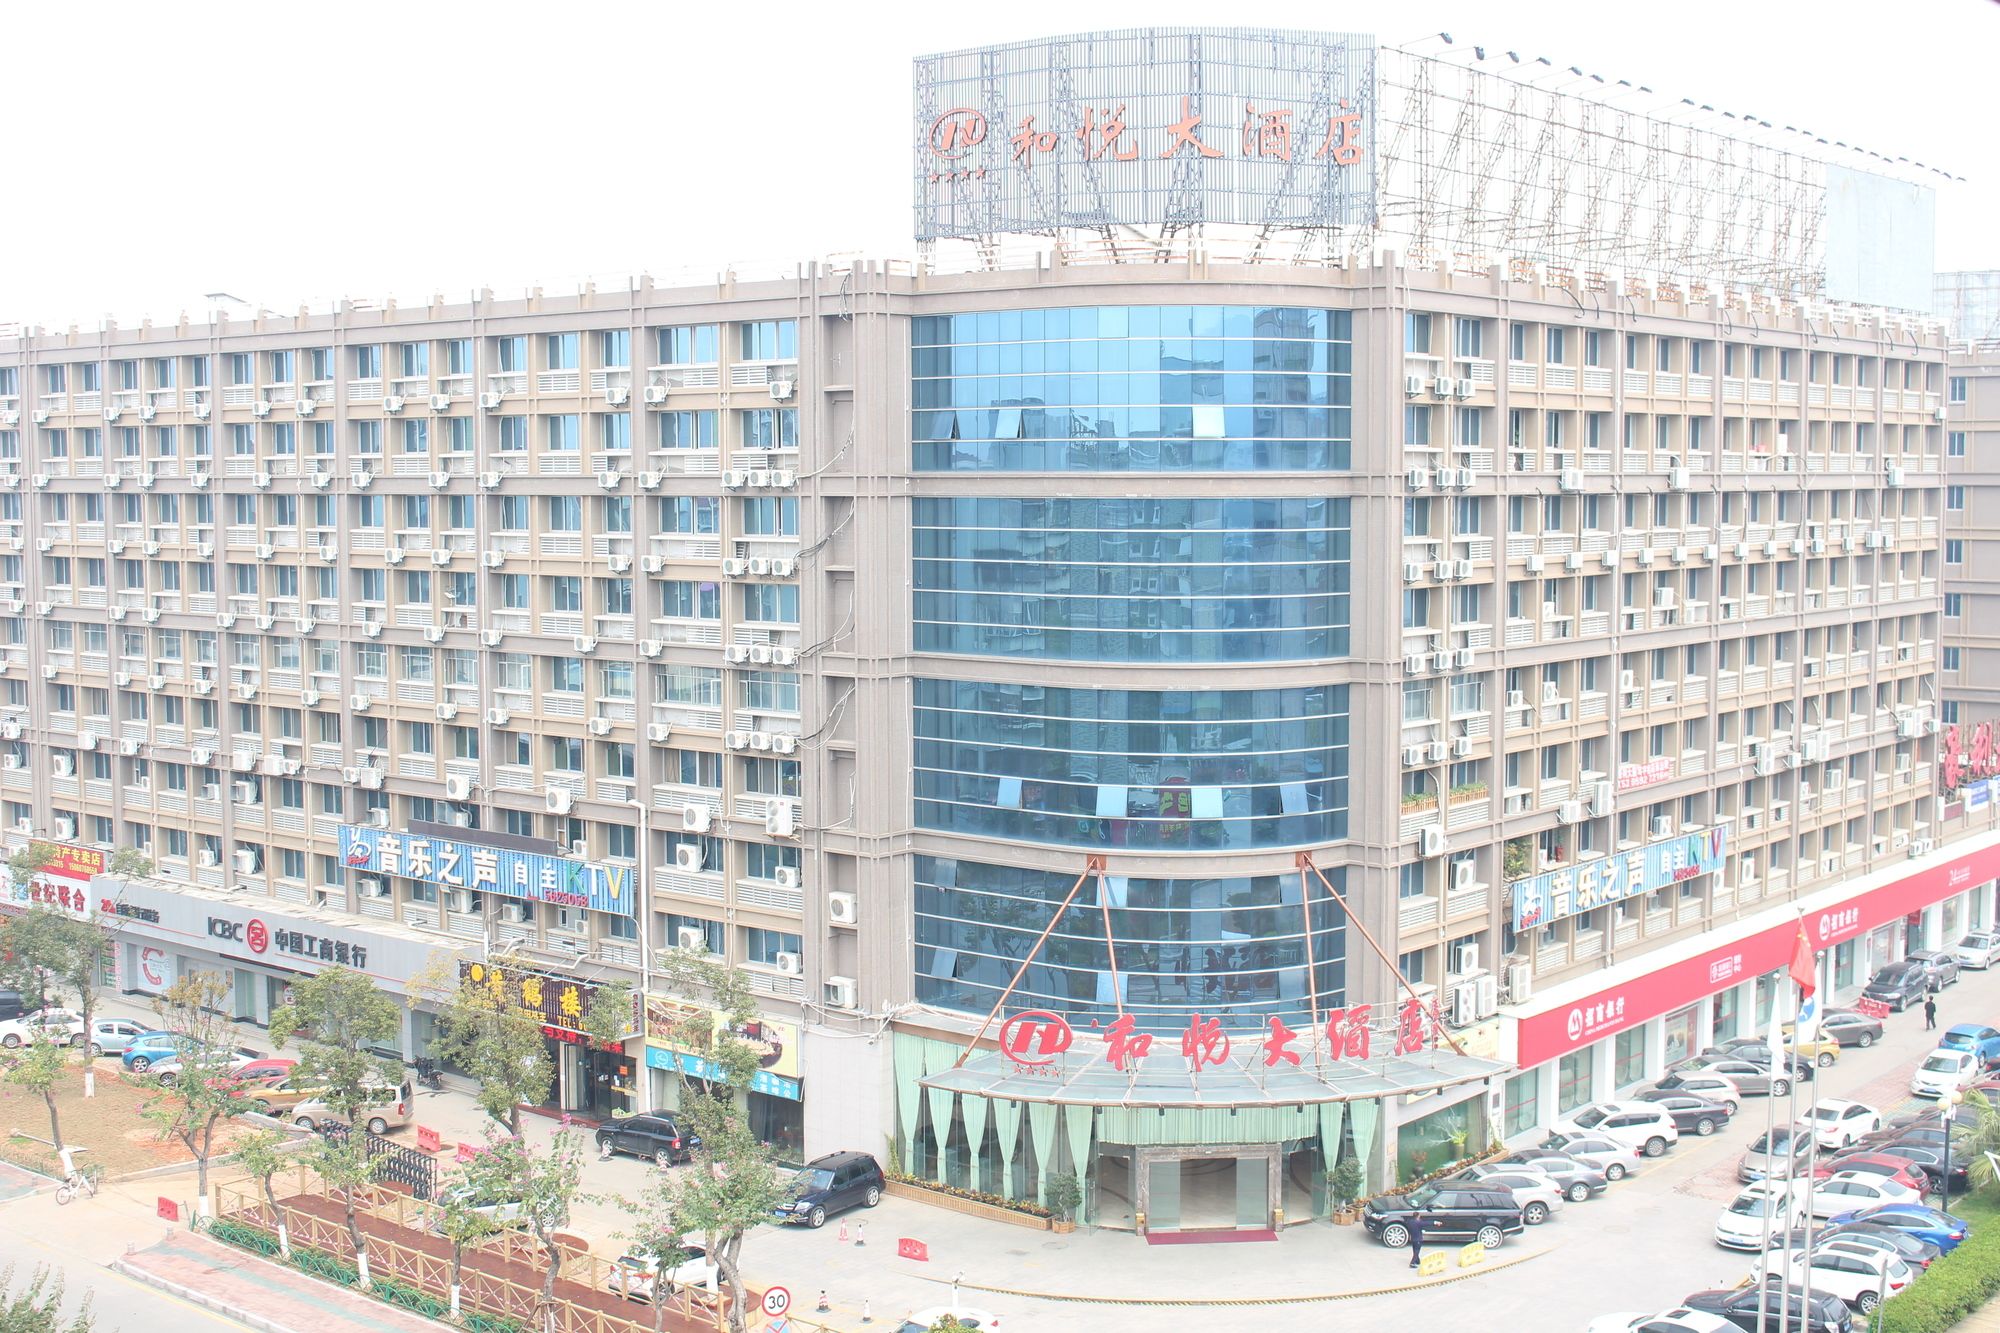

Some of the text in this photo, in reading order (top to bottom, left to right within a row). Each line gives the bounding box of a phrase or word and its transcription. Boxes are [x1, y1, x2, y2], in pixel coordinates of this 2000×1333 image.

[1010, 96, 1364, 169] 和悦大酒店
[376, 833, 498, 888] 音乐之声
[567, 863, 625, 899] KTV
[1551, 852, 1646, 917] 音乐之声
[1687, 827, 1723, 865] KTV
[207, 916, 243, 943] ICBC
[275, 928, 367, 969] 中国工商银行
[1091, 997, 1425, 1073] 和悦大酒店
[768, 1294, 786, 1310] 30
